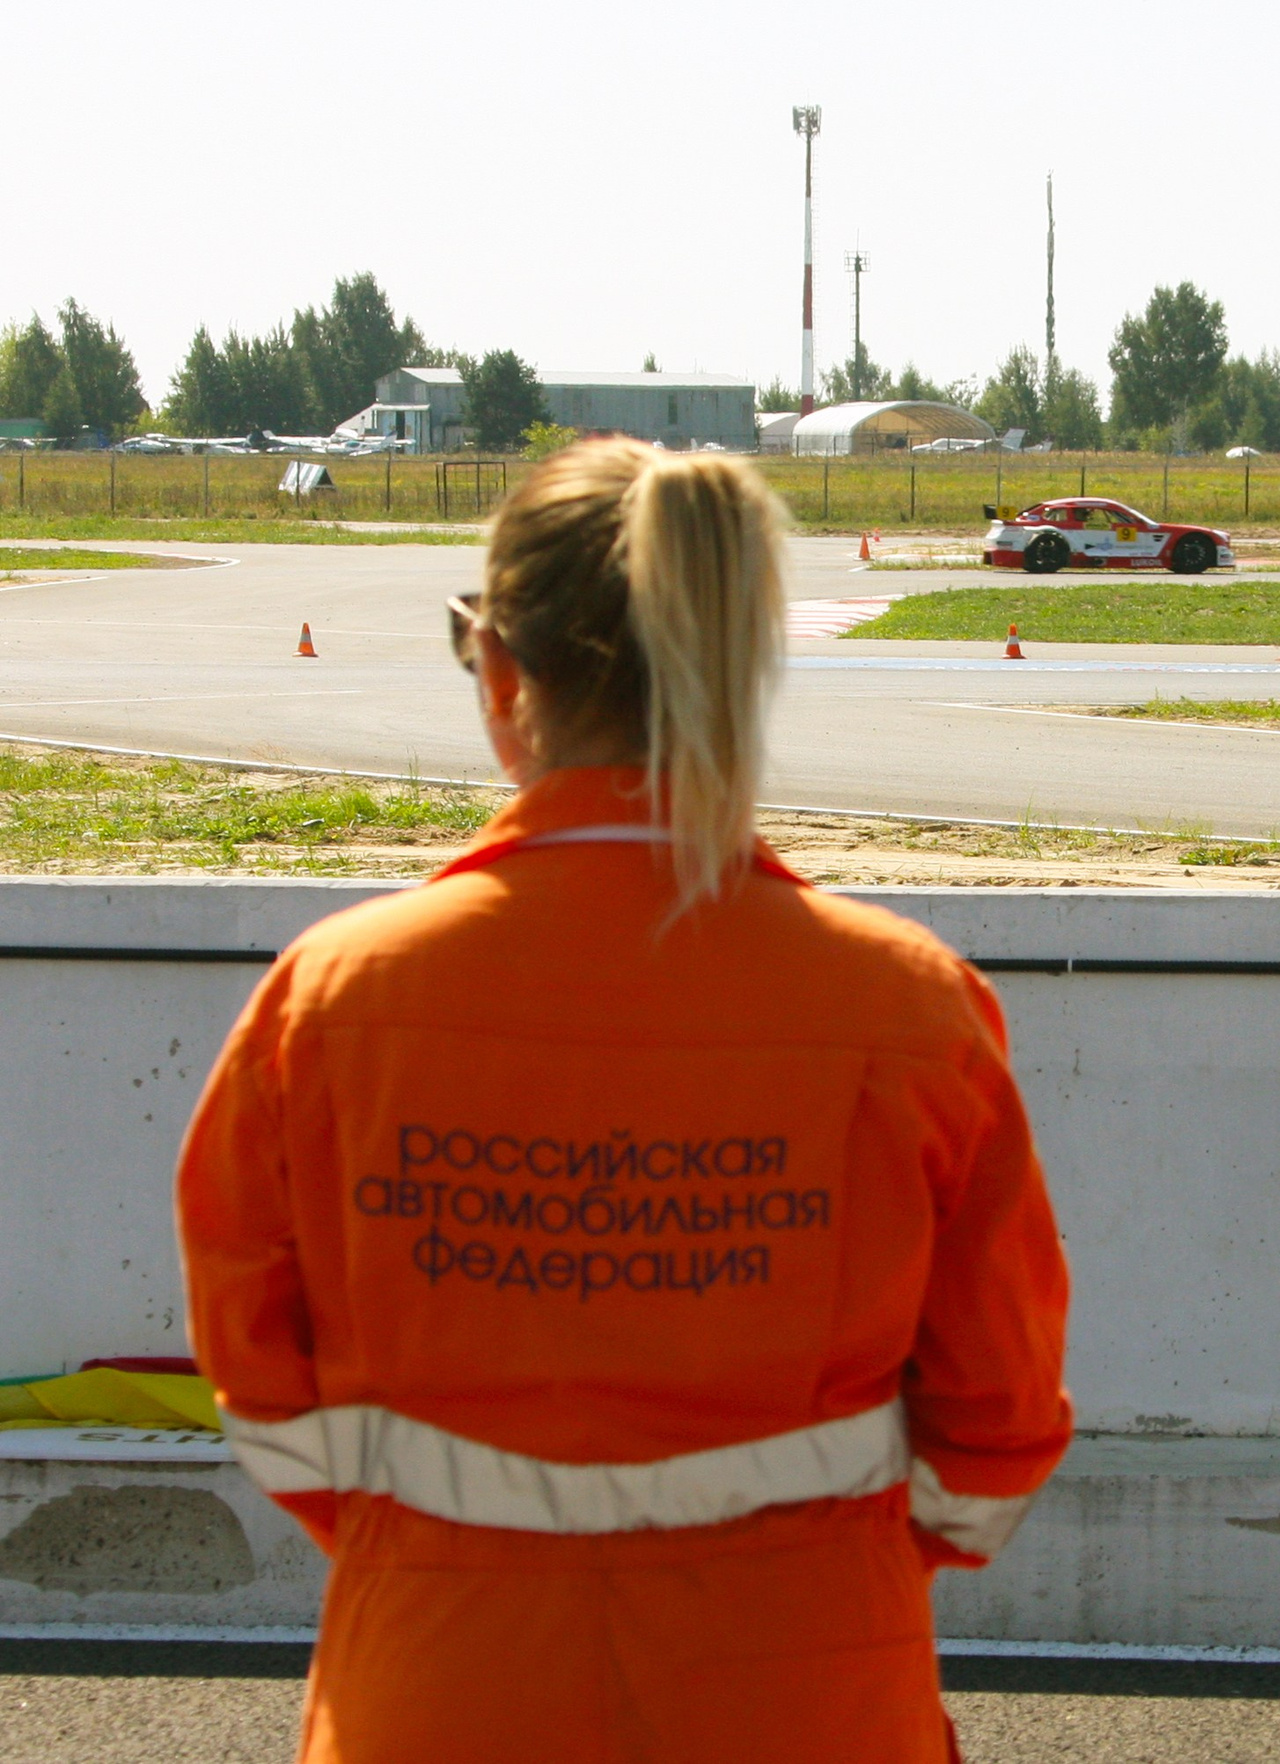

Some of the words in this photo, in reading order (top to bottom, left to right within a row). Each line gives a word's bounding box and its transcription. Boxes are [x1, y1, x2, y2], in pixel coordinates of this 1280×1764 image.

[1001, 507, 1010, 517] 9
[1121, 527, 1131, 541] 9
[399, 1123, 788, 1180] российская
[354, 1175, 831, 1236] автомобильная
[412, 1225, 771, 1302] федерация
